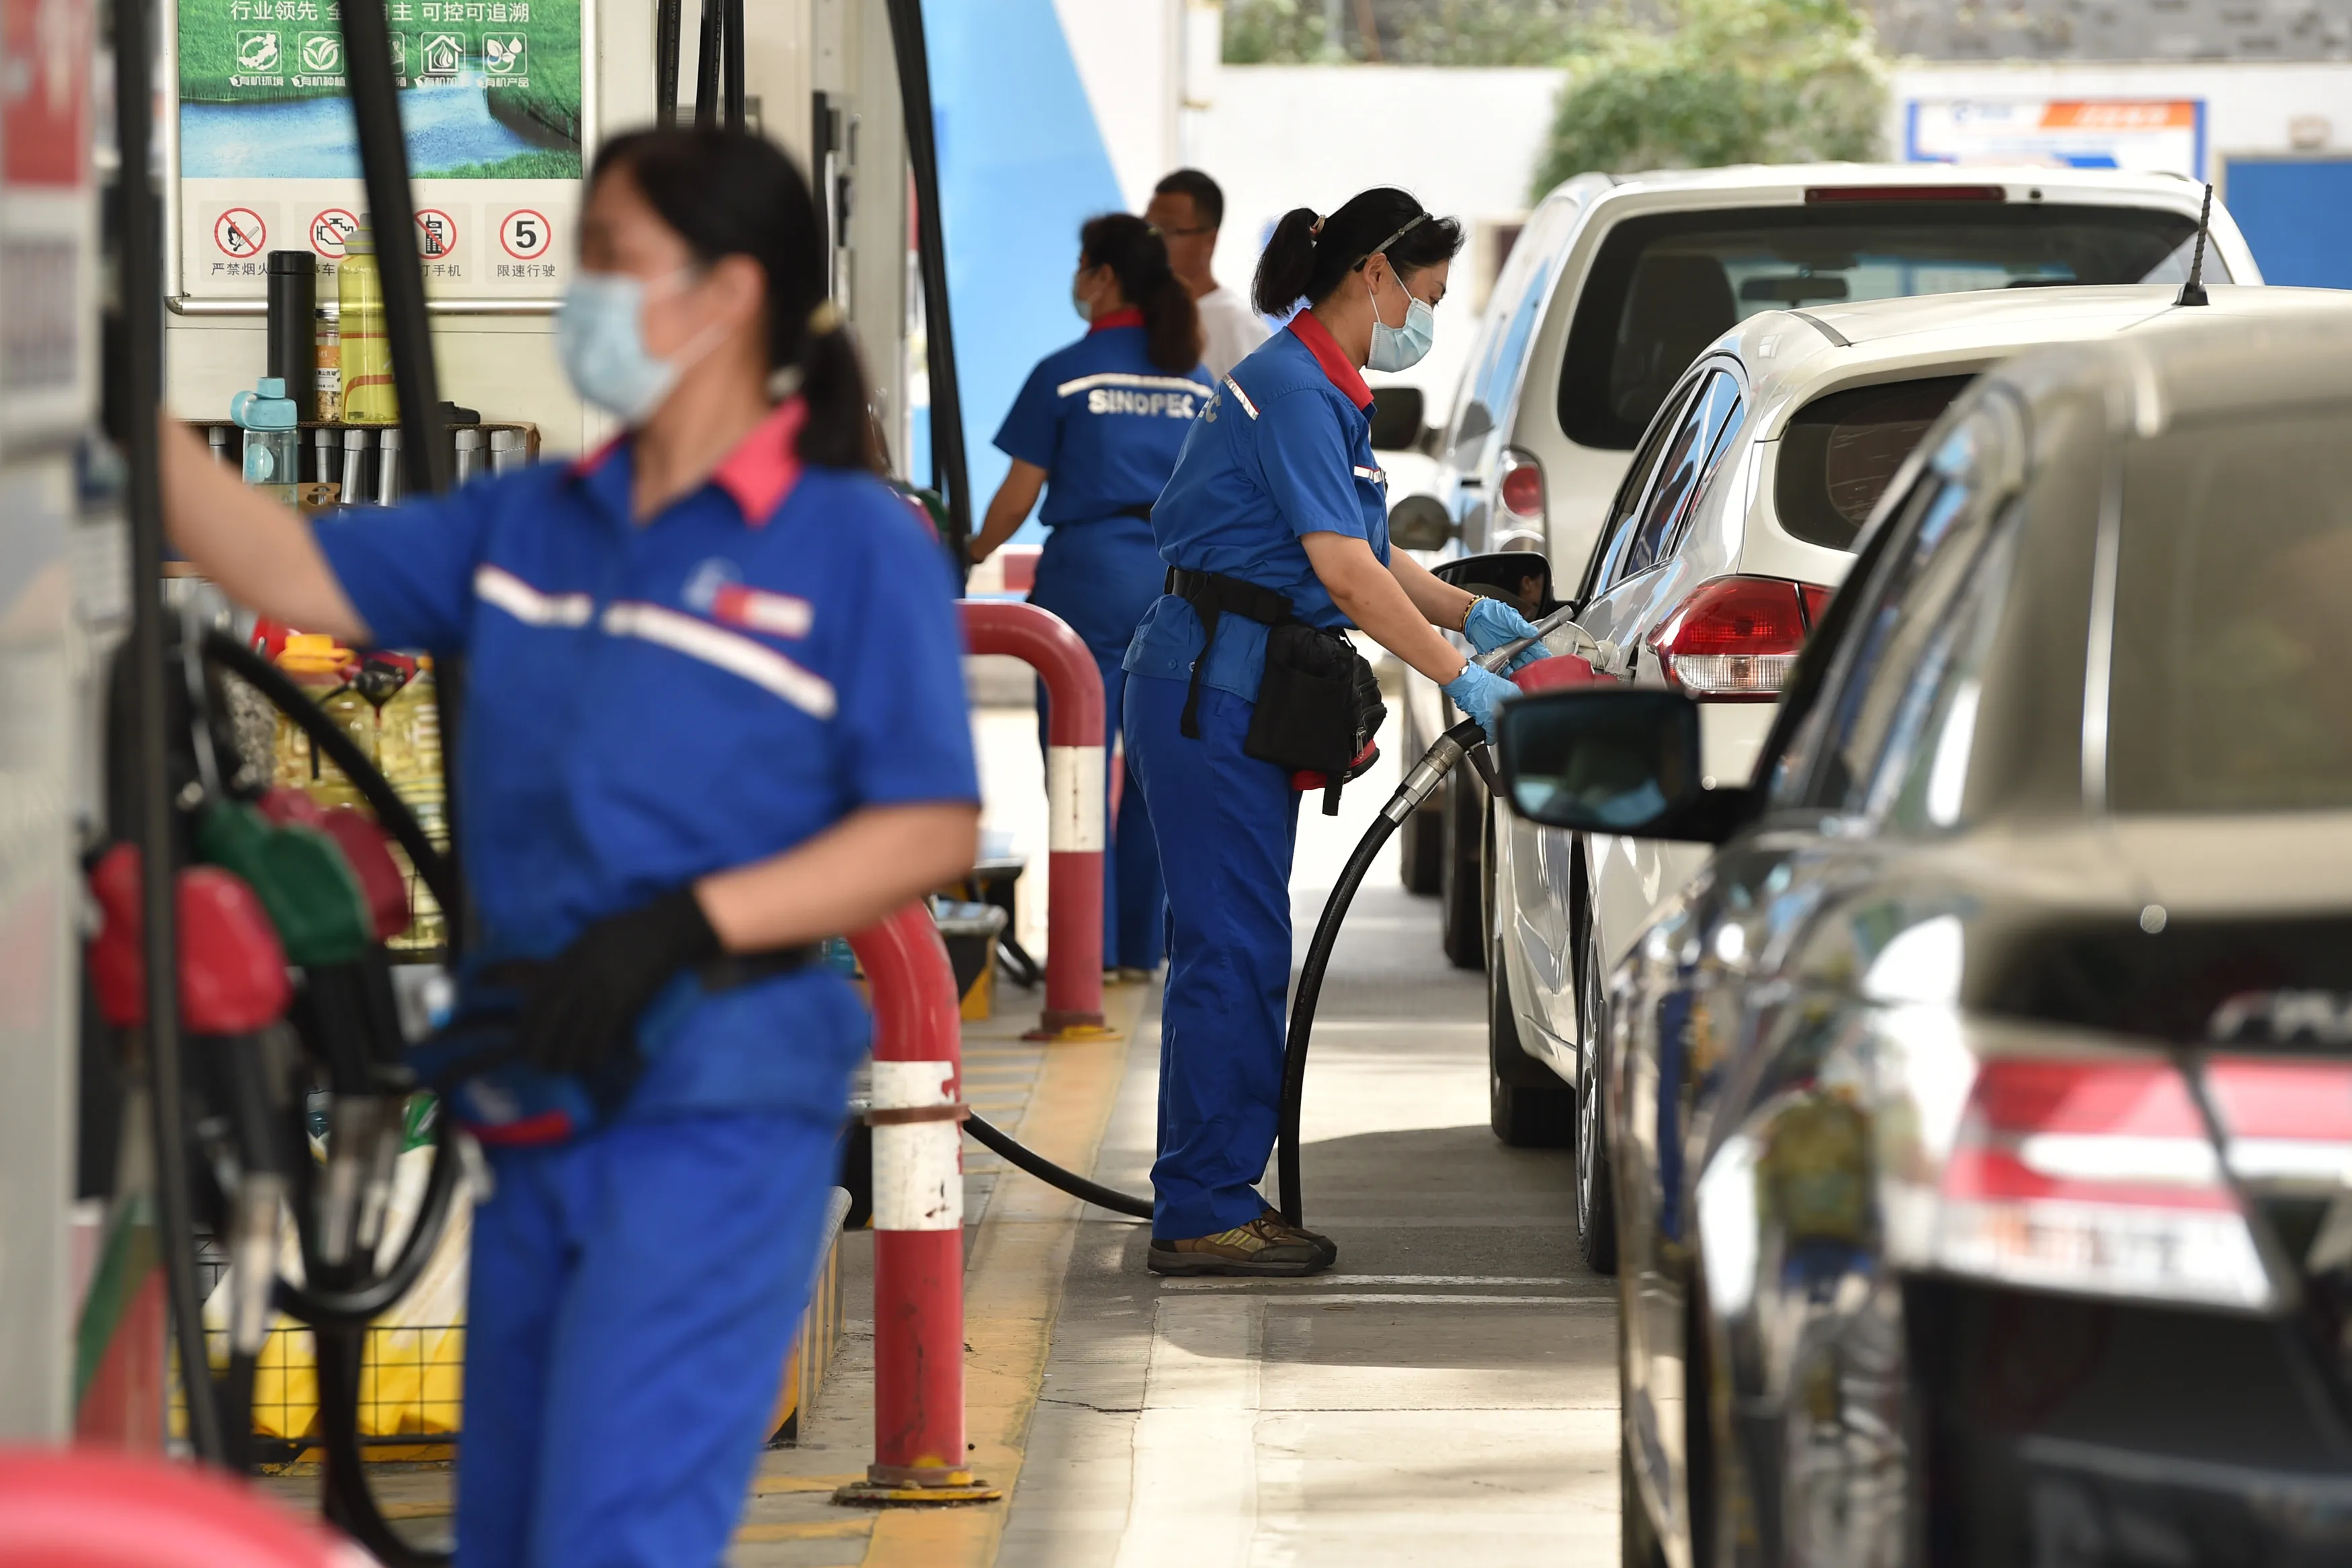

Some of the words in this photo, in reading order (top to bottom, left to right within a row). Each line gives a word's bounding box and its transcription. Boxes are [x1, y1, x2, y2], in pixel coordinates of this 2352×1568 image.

[230, 1, 318, 21] 行业领先
[326, 1, 413, 21] 全主
[421, 3, 530, 23] 可控可追溯
[485, 77, 530, 88] 有机产品
[516, 220, 537, 249] 5
[497, 264, 556, 277] 限速行驶
[1088, 388, 1195, 420] SINOPEC
